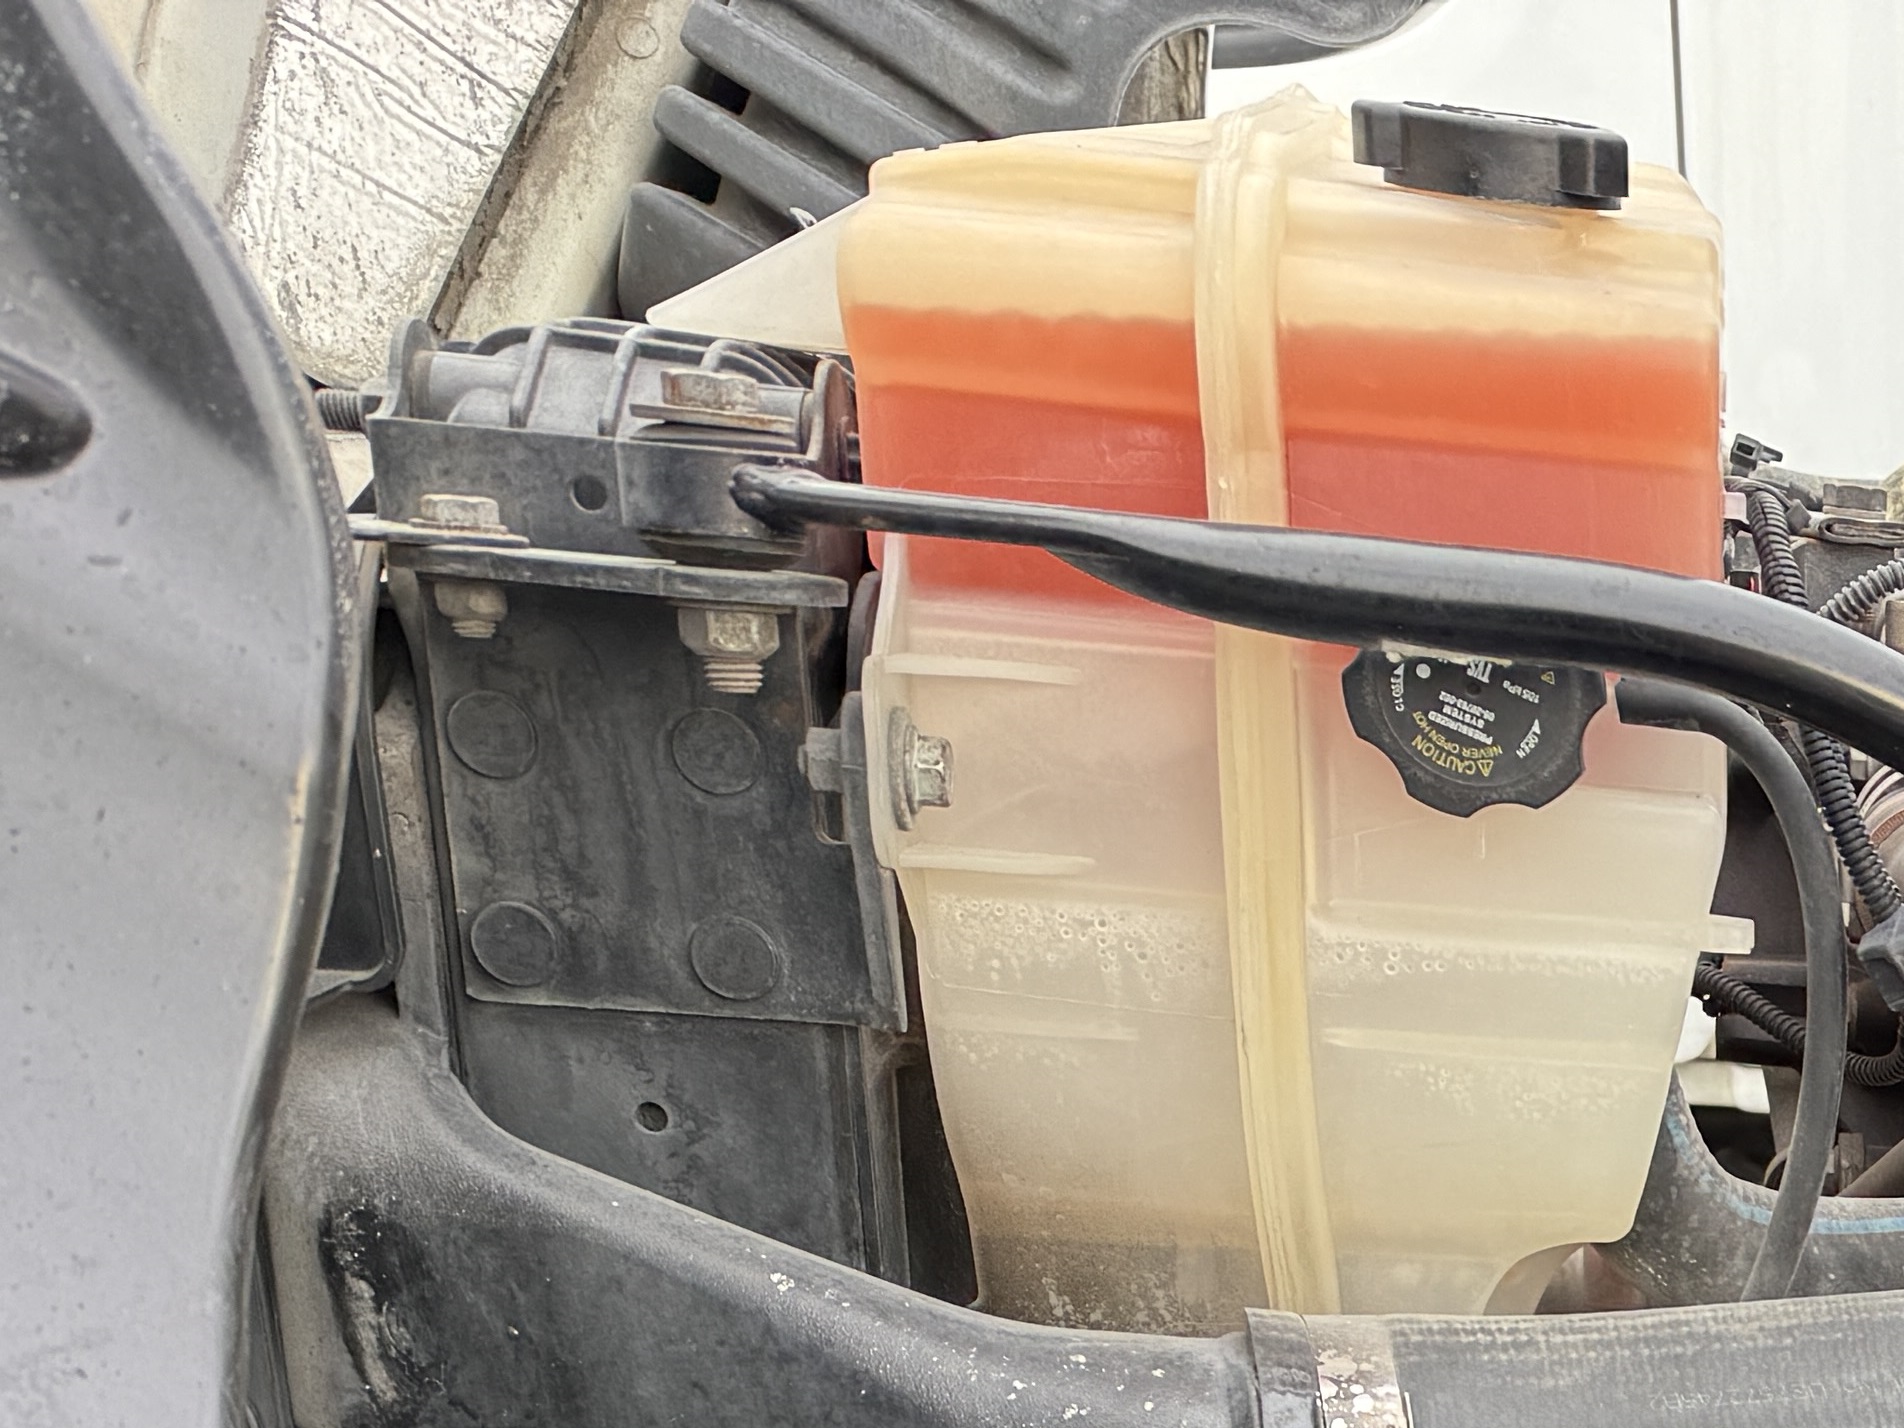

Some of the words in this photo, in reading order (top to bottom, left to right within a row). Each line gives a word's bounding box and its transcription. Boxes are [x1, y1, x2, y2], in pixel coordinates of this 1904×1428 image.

[1411, 734, 1477, 776] CAUTION
[1428, 729, 1460, 756] OPEN
[1462, 744, 1504, 760] NEVER
